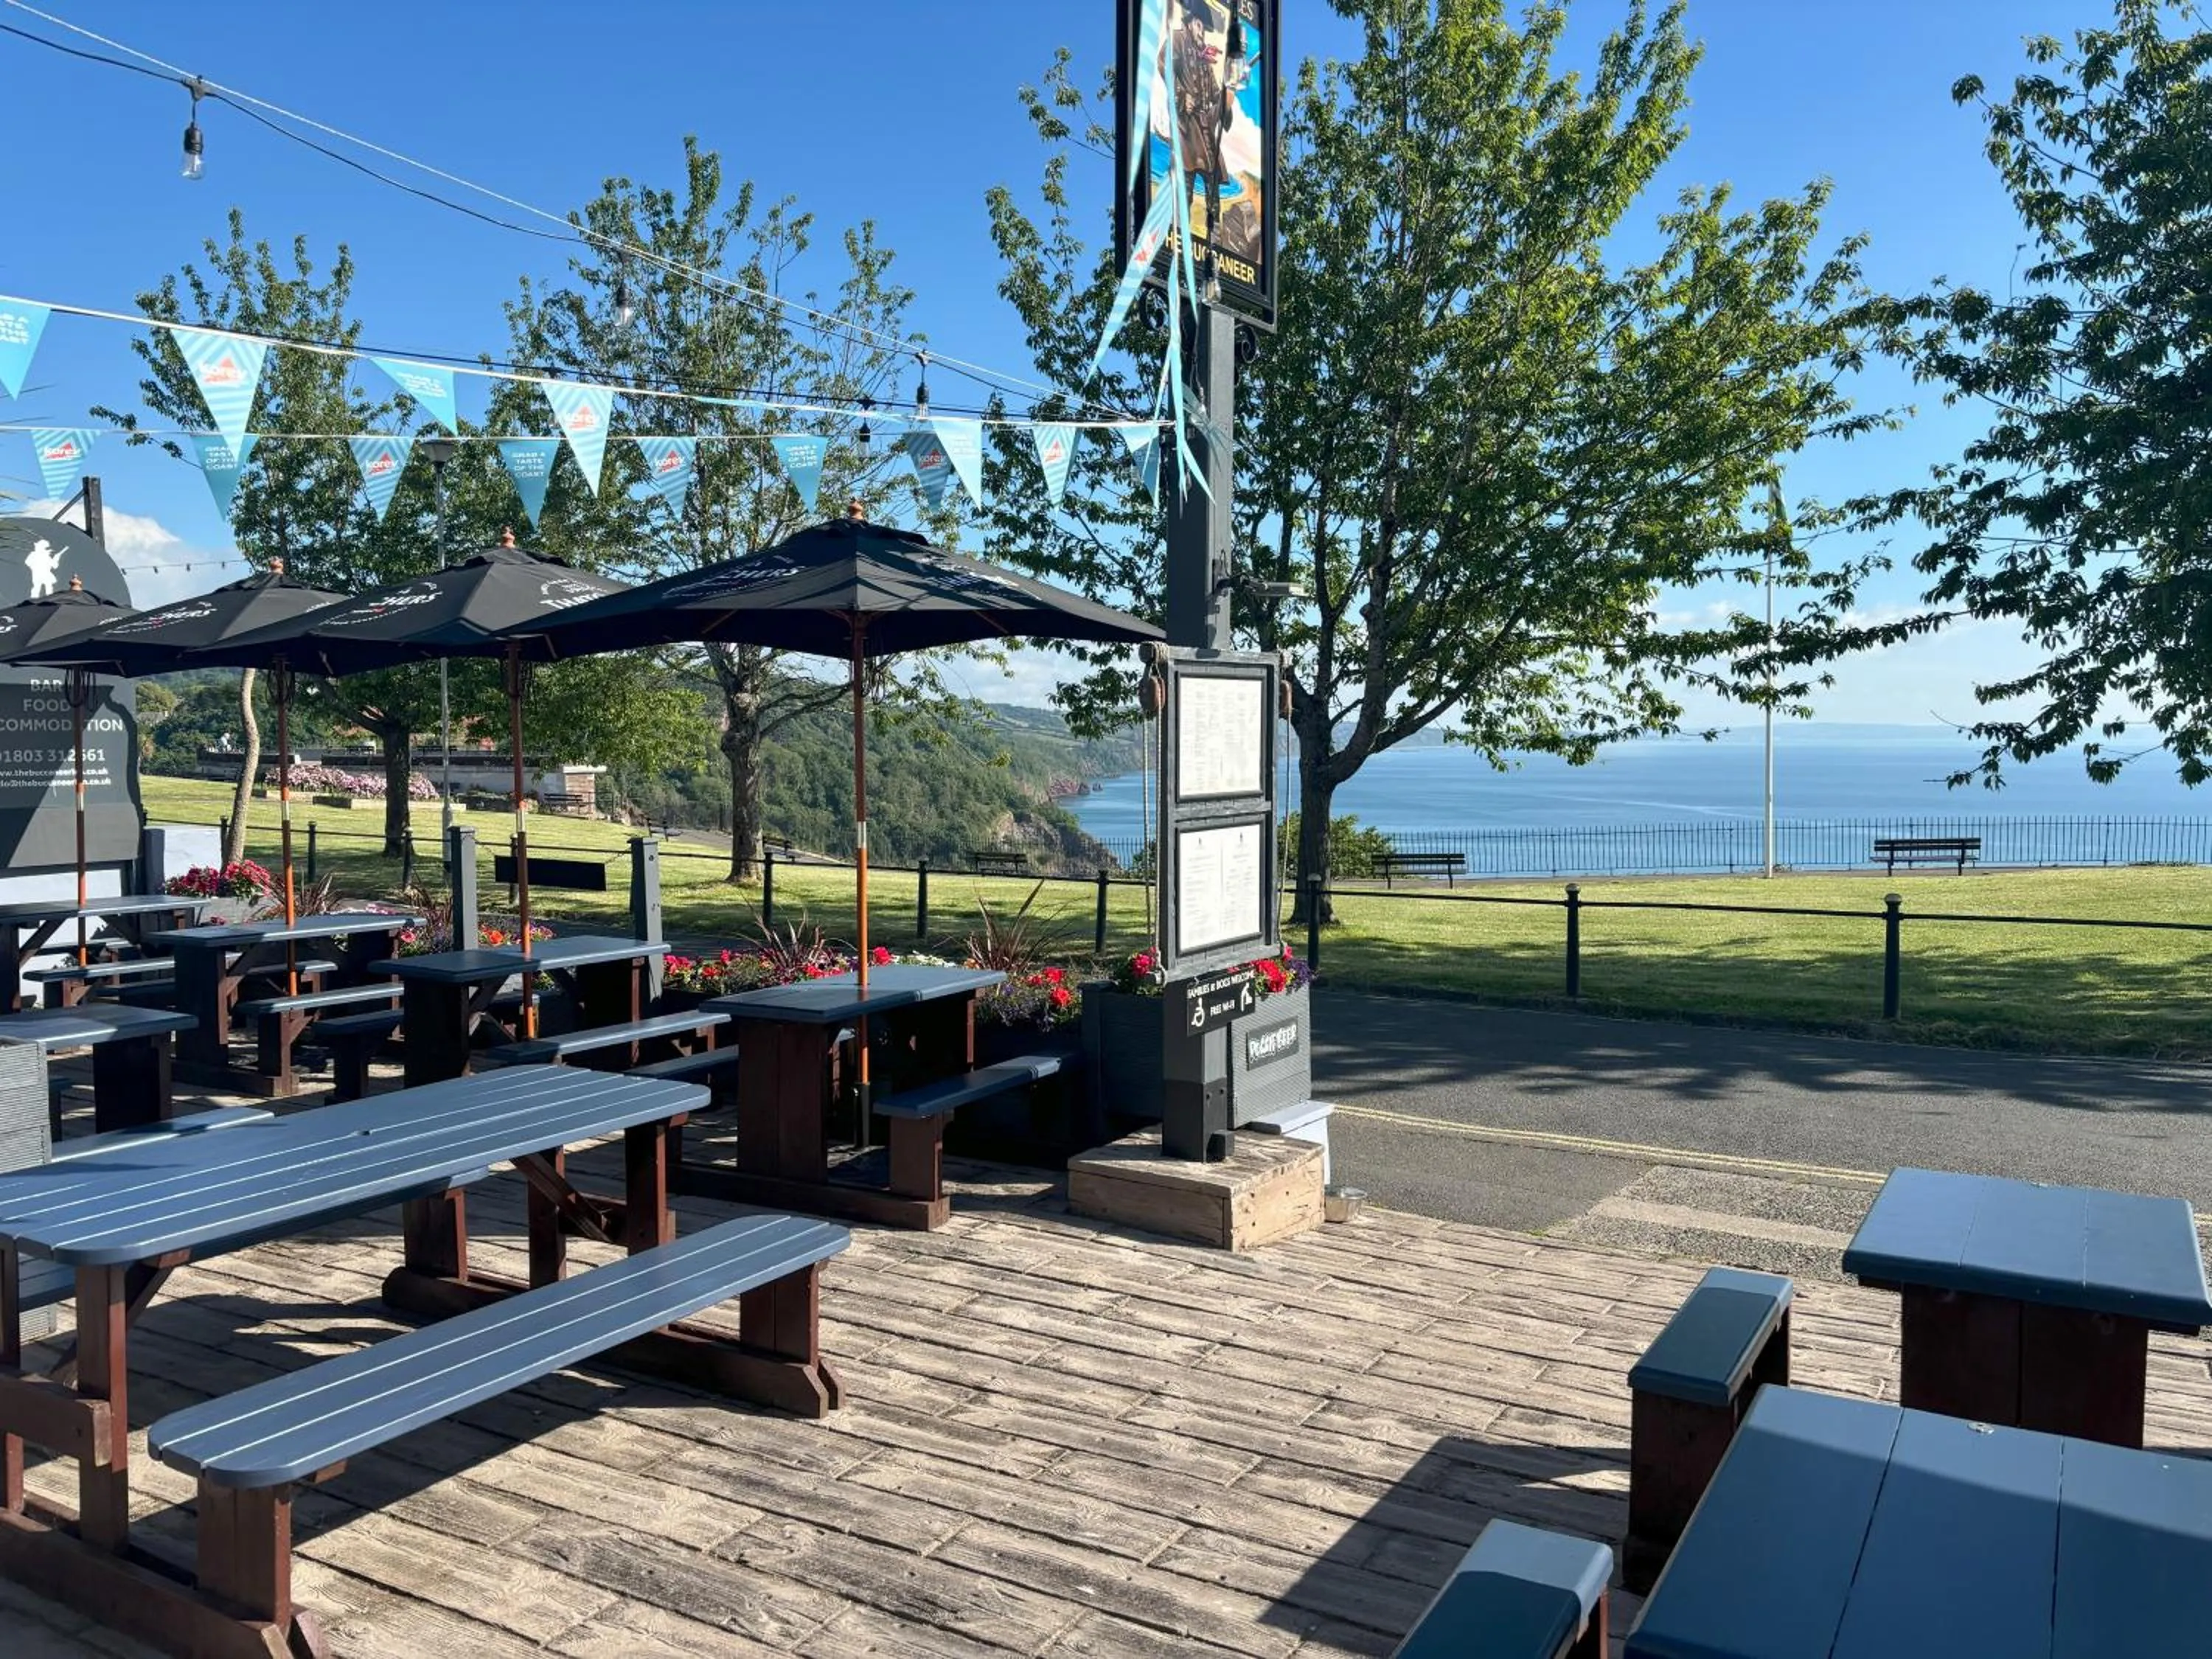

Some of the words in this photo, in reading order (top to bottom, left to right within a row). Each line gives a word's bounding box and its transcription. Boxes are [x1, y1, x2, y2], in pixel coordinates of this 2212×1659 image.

[30, 679, 63, 692] BAR
[23, 699, 71, 712] FOOD
[0, 719, 124, 731] OMMODTION
[0, 749, 42, 762] 1803
[1217, 976, 1231, 990] DOGS
[1210, 1004, 1222, 1015] FREE
